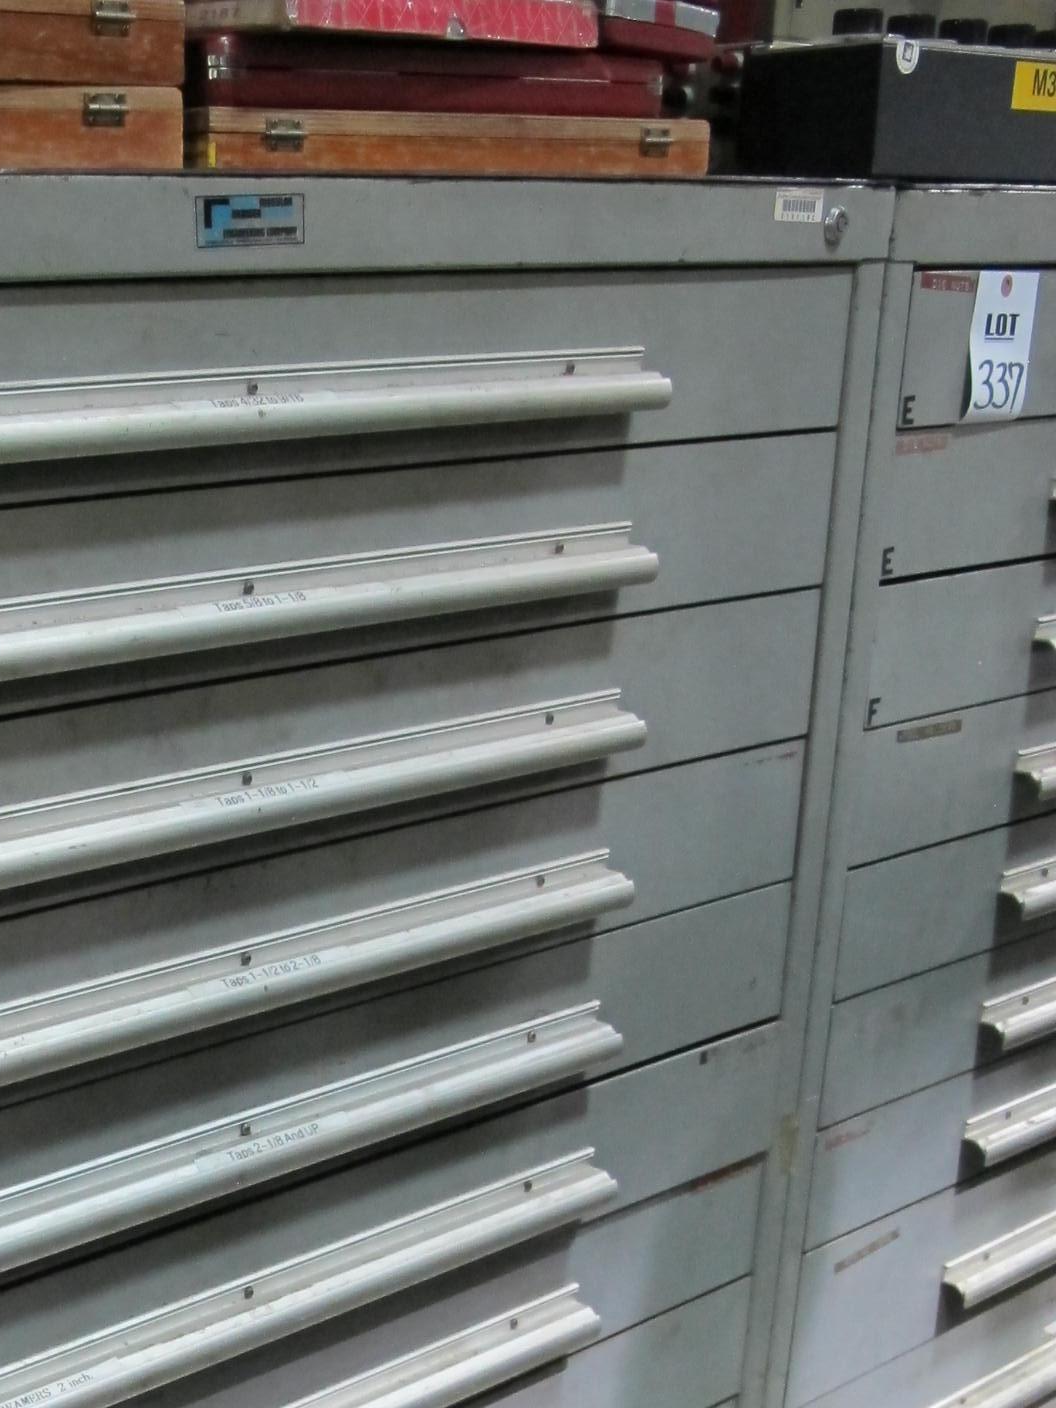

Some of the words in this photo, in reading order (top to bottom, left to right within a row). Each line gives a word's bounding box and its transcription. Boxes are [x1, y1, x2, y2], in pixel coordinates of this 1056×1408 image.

[984, 313, 1020, 337] LOT
[974, 359, 1025, 414] 337
[901, 395, 916, 425] E
[881, 546, 894, 577] E
[214, 601, 243, 613] Taps
[866, 697, 882, 726] F
[216, 795, 244, 807] Taps
[221, 977, 250, 989] Taps
[226, 1147, 254, 1161] Taps
[285, 1127, 305, 1143] And
[304, 1122, 320, 1137] UP
[56, 1382, 67, 1394] 2
